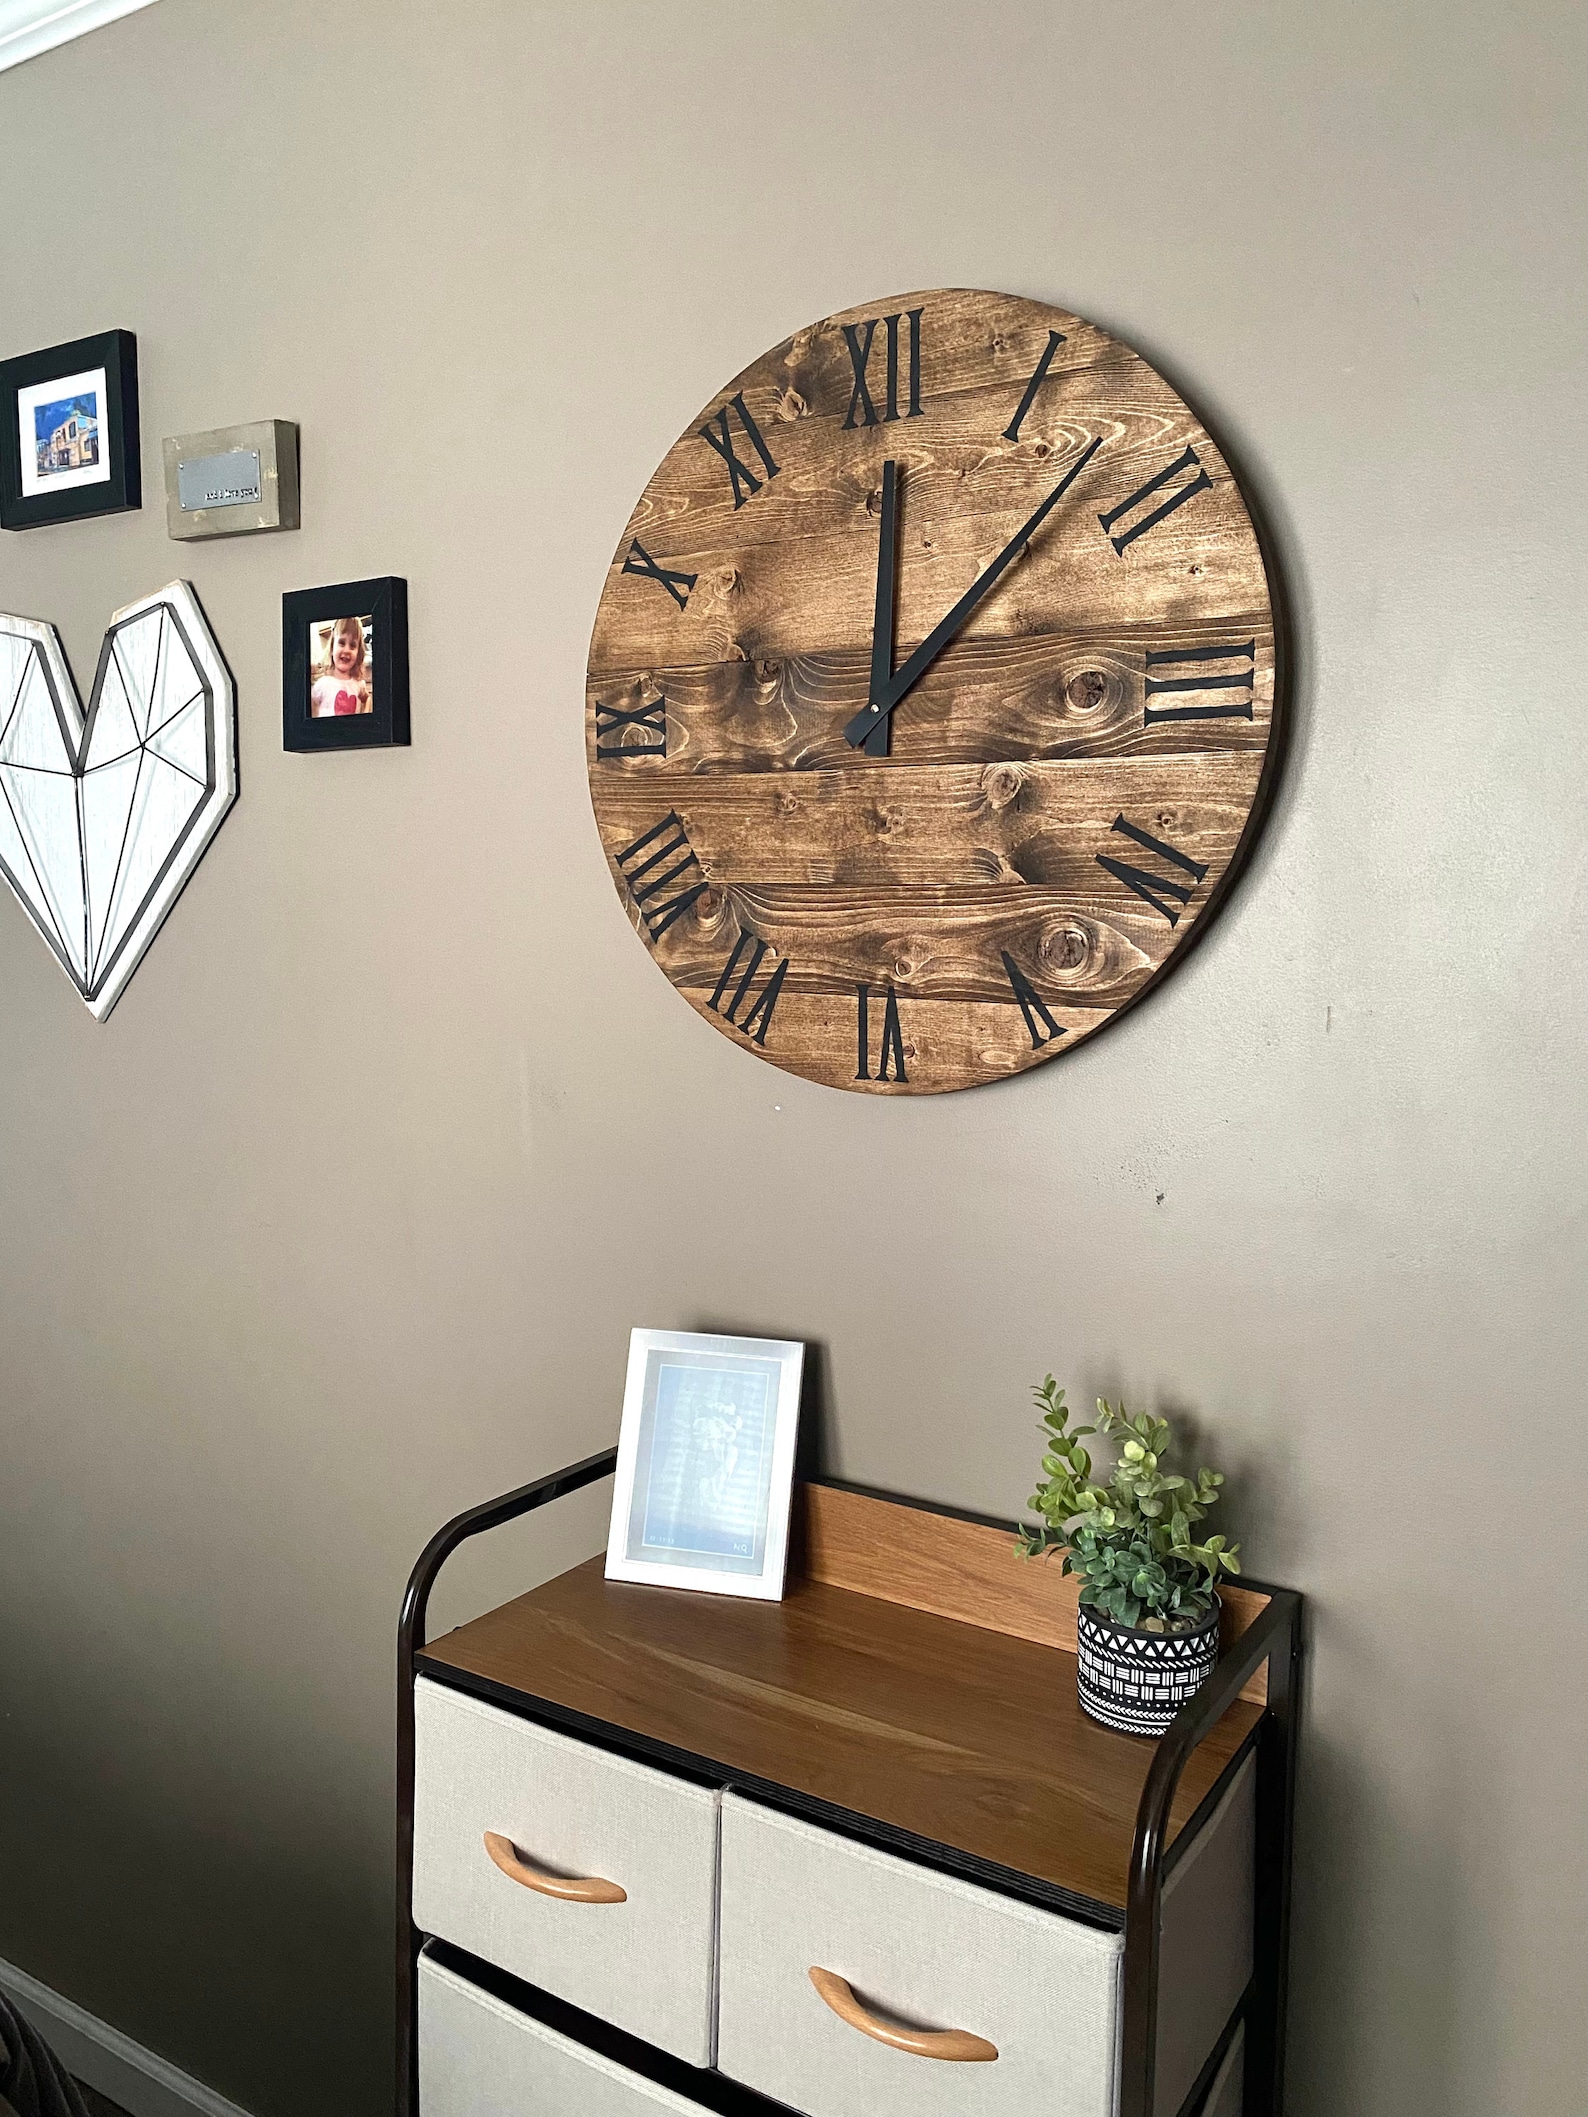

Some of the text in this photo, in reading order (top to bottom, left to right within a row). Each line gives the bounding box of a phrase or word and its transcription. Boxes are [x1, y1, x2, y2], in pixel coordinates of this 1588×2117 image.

[841, 308, 925, 431] XII
[1003, 330, 1068, 443] I
[701, 390, 782, 512] XI
[1097, 444, 1216, 558] II
[621, 537, 699, 612] X
[595, 694, 668, 761] IX
[1144, 637, 1256, 729] III
[614, 808, 711, 944] VIII
[1096, 812, 1211, 926] IV
[706, 925, 790, 1047] VII
[854, 983, 910, 1083] VI
[1001, 950, 1069, 1051] V
